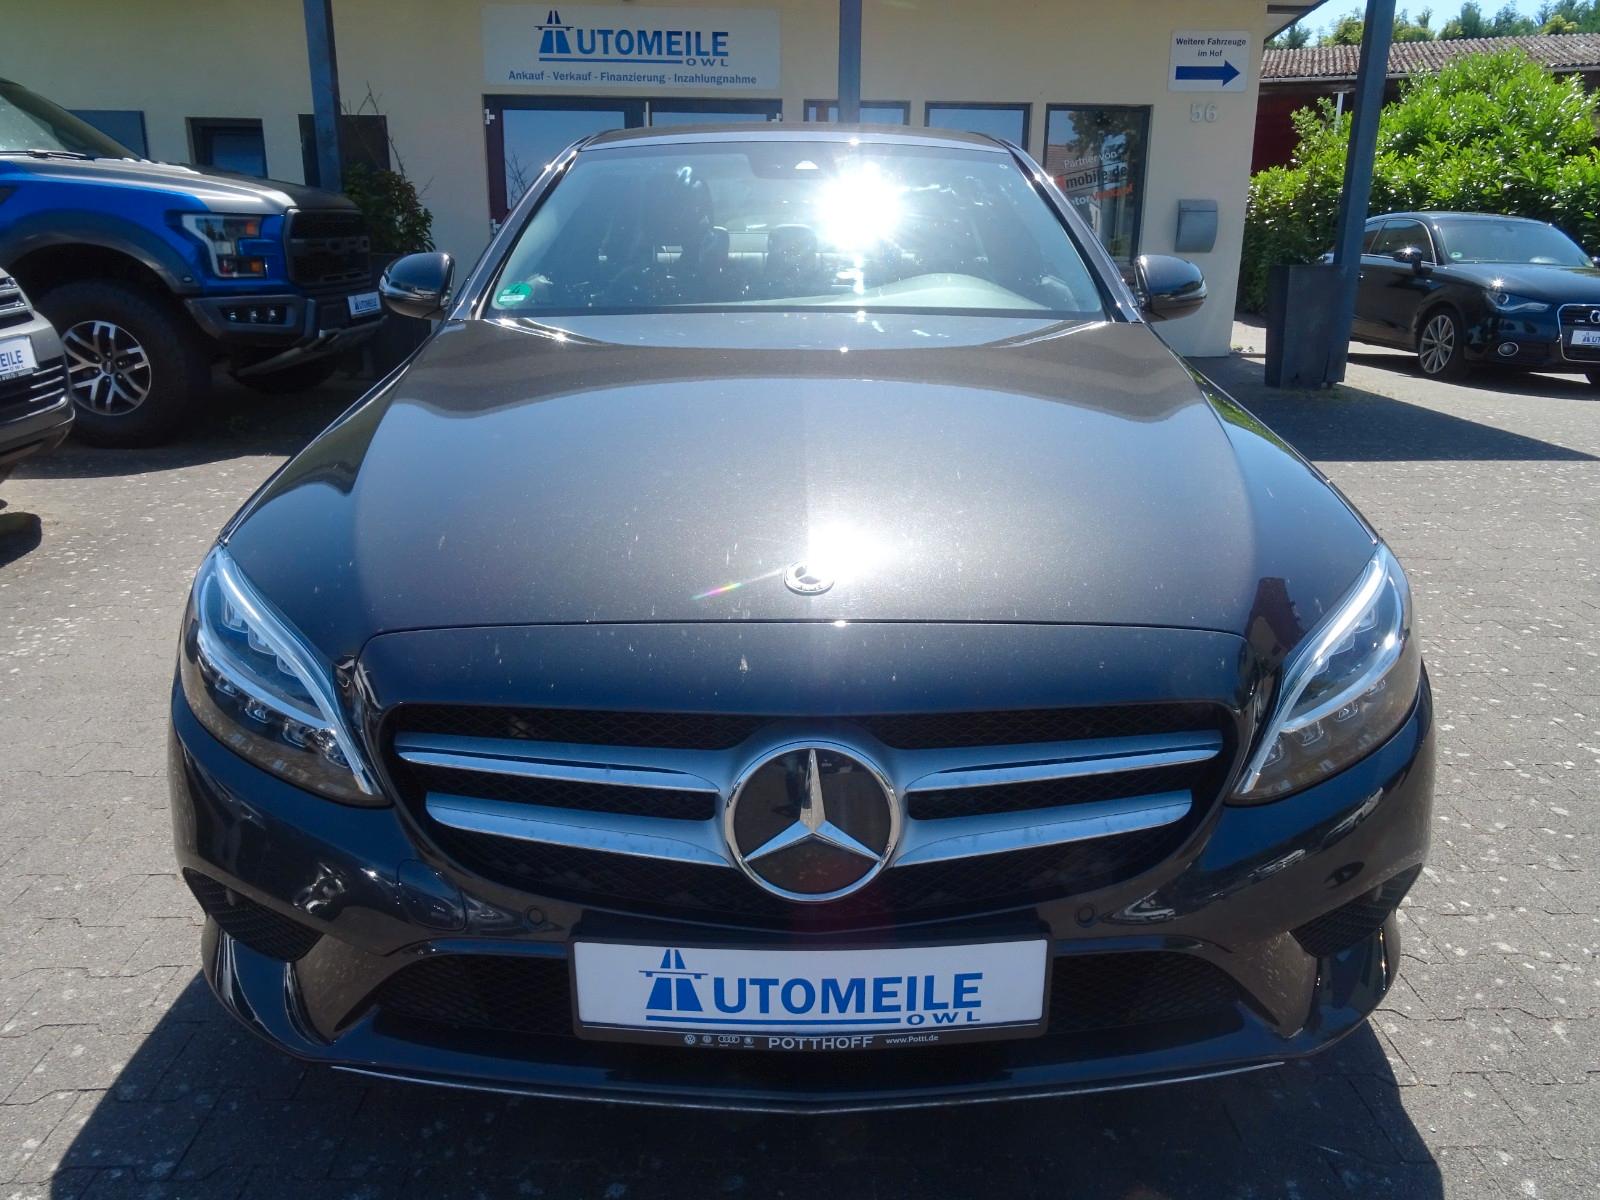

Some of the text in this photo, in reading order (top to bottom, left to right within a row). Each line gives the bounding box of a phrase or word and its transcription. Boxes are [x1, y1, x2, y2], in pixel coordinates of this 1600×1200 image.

[1176, 37, 1247, 47] Weitere Fahrzeuge
[1209, 49, 1223, 57] Hof
[685, 57, 729, 67] OWL
[508, 70, 545, 81] Ankauf
[552, 71, 592, 82] Verkauf
[600, 72, 666, 84] Finanzierung
[674, 73, 757, 85] Inzahlungnahme
[1190, 101, 1217, 123] 56
[1063, 155, 1098, 168] Partner
[907, 1011, 981, 1026] OWL
[768, 1036, 874, 1050] POTTHOFF
